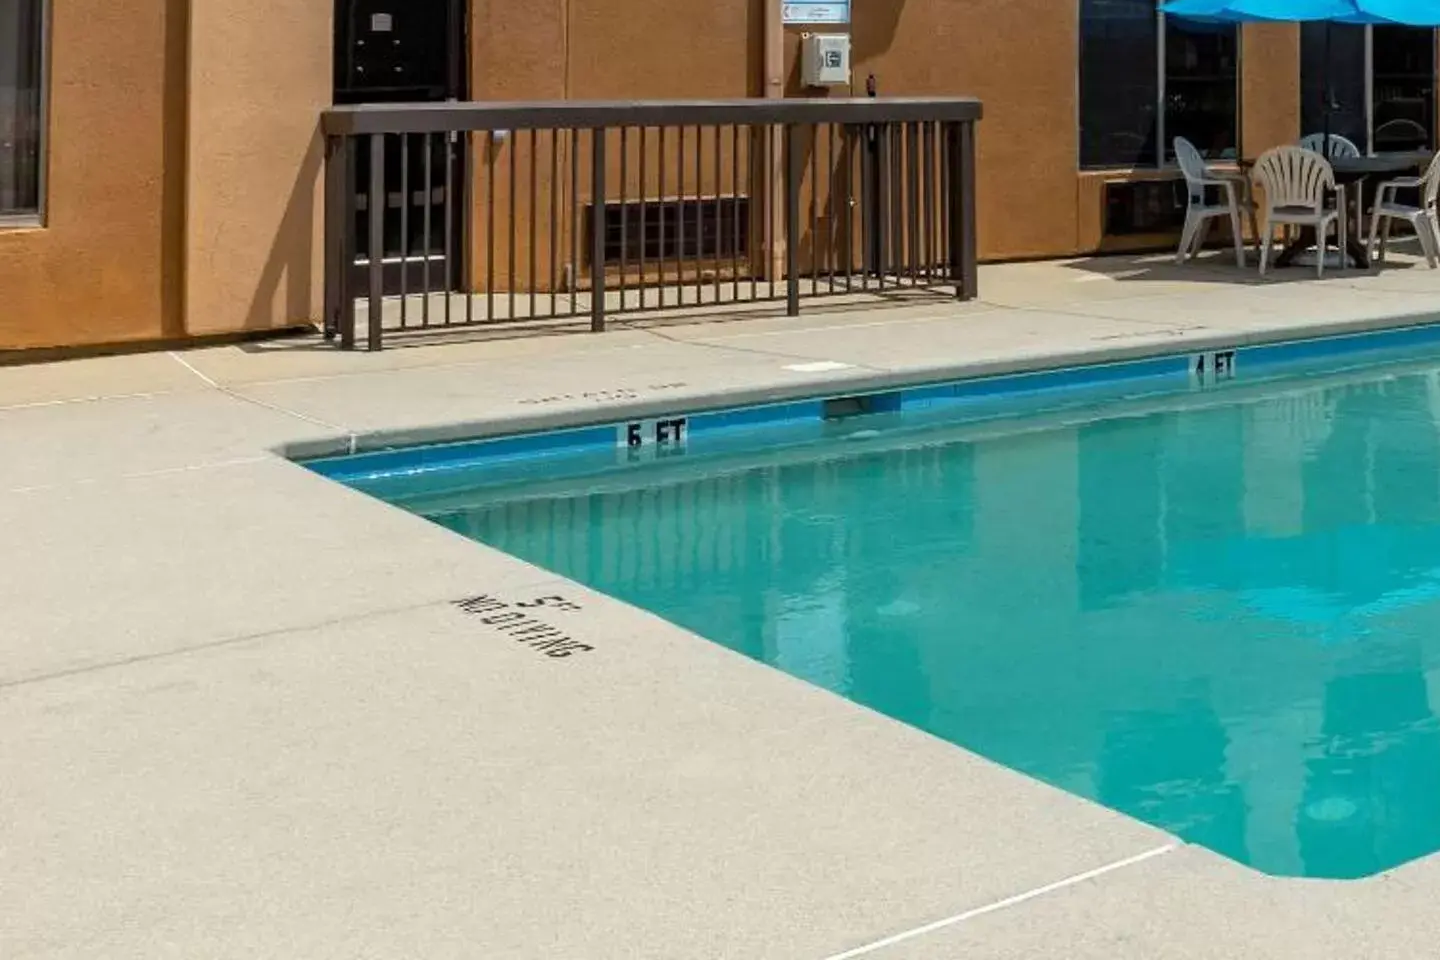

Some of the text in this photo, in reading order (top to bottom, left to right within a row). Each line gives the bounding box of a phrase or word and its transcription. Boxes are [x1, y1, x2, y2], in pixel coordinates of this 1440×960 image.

[656, 419, 687, 443] FT
[449, 593, 596, 658] NO DIVING
